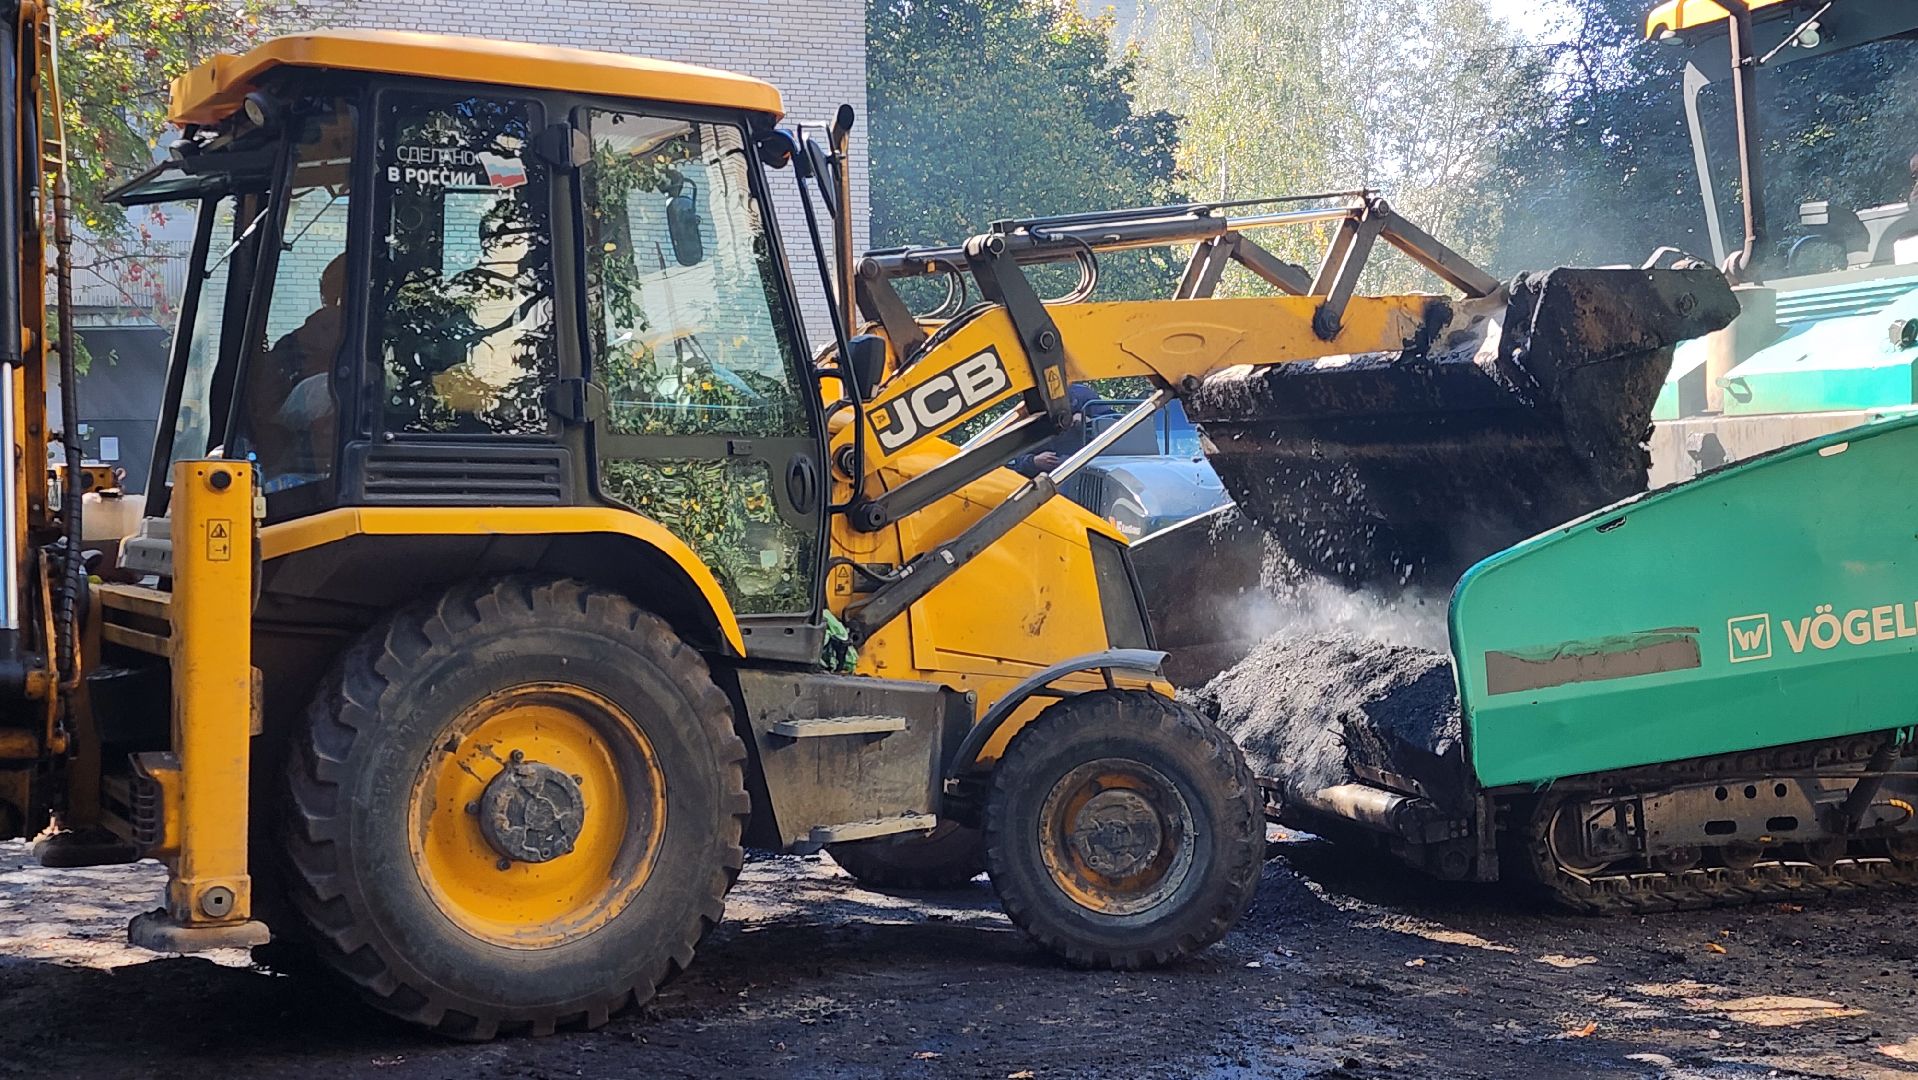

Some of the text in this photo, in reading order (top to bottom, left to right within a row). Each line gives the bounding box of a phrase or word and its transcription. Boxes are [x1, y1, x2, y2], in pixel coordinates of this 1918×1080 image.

[396, 145, 476, 166] СДЕЛАНО
[387, 166, 477, 186] В РОССИИ
[879, 352, 1006, 449] JCB
[1781, 601, 1918, 653] VÖGEL
